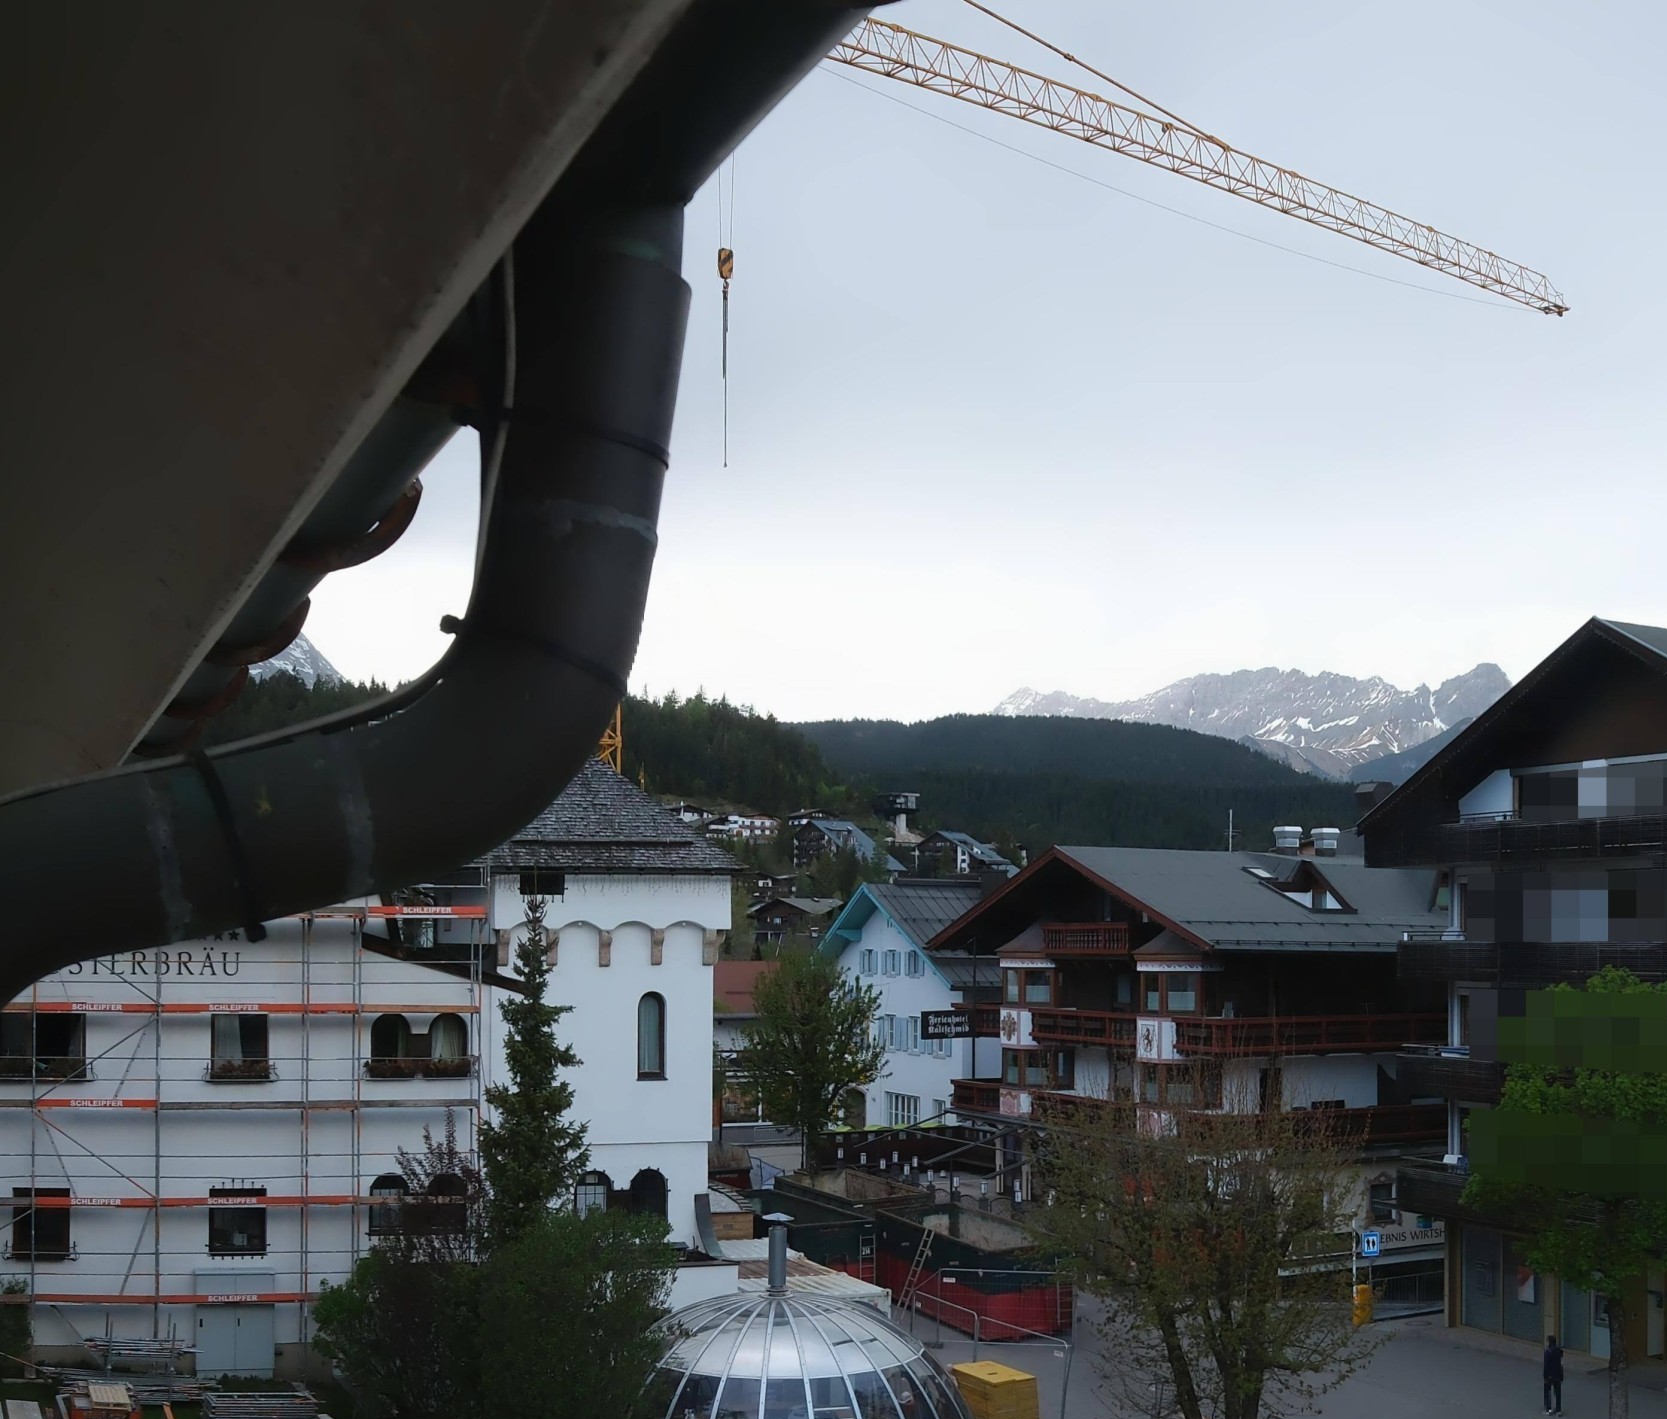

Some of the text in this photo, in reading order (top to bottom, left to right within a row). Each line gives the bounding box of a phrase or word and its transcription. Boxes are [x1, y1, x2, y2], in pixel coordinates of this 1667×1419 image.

[402, 906, 452, 914] SCHLEIPFER
[72, 1003, 122, 1011] SCHLEIPFER
[208, 1003, 259, 1011] SCHLEIPFER
[70, 1099, 123, 1107] SCHLEIPFER
[70, 1198, 121, 1206] SCHLEIPFER
[207, 1197, 257, 1205] SCHLEIPFER
[207, 1294, 258, 1302] SCHLEIPFER
